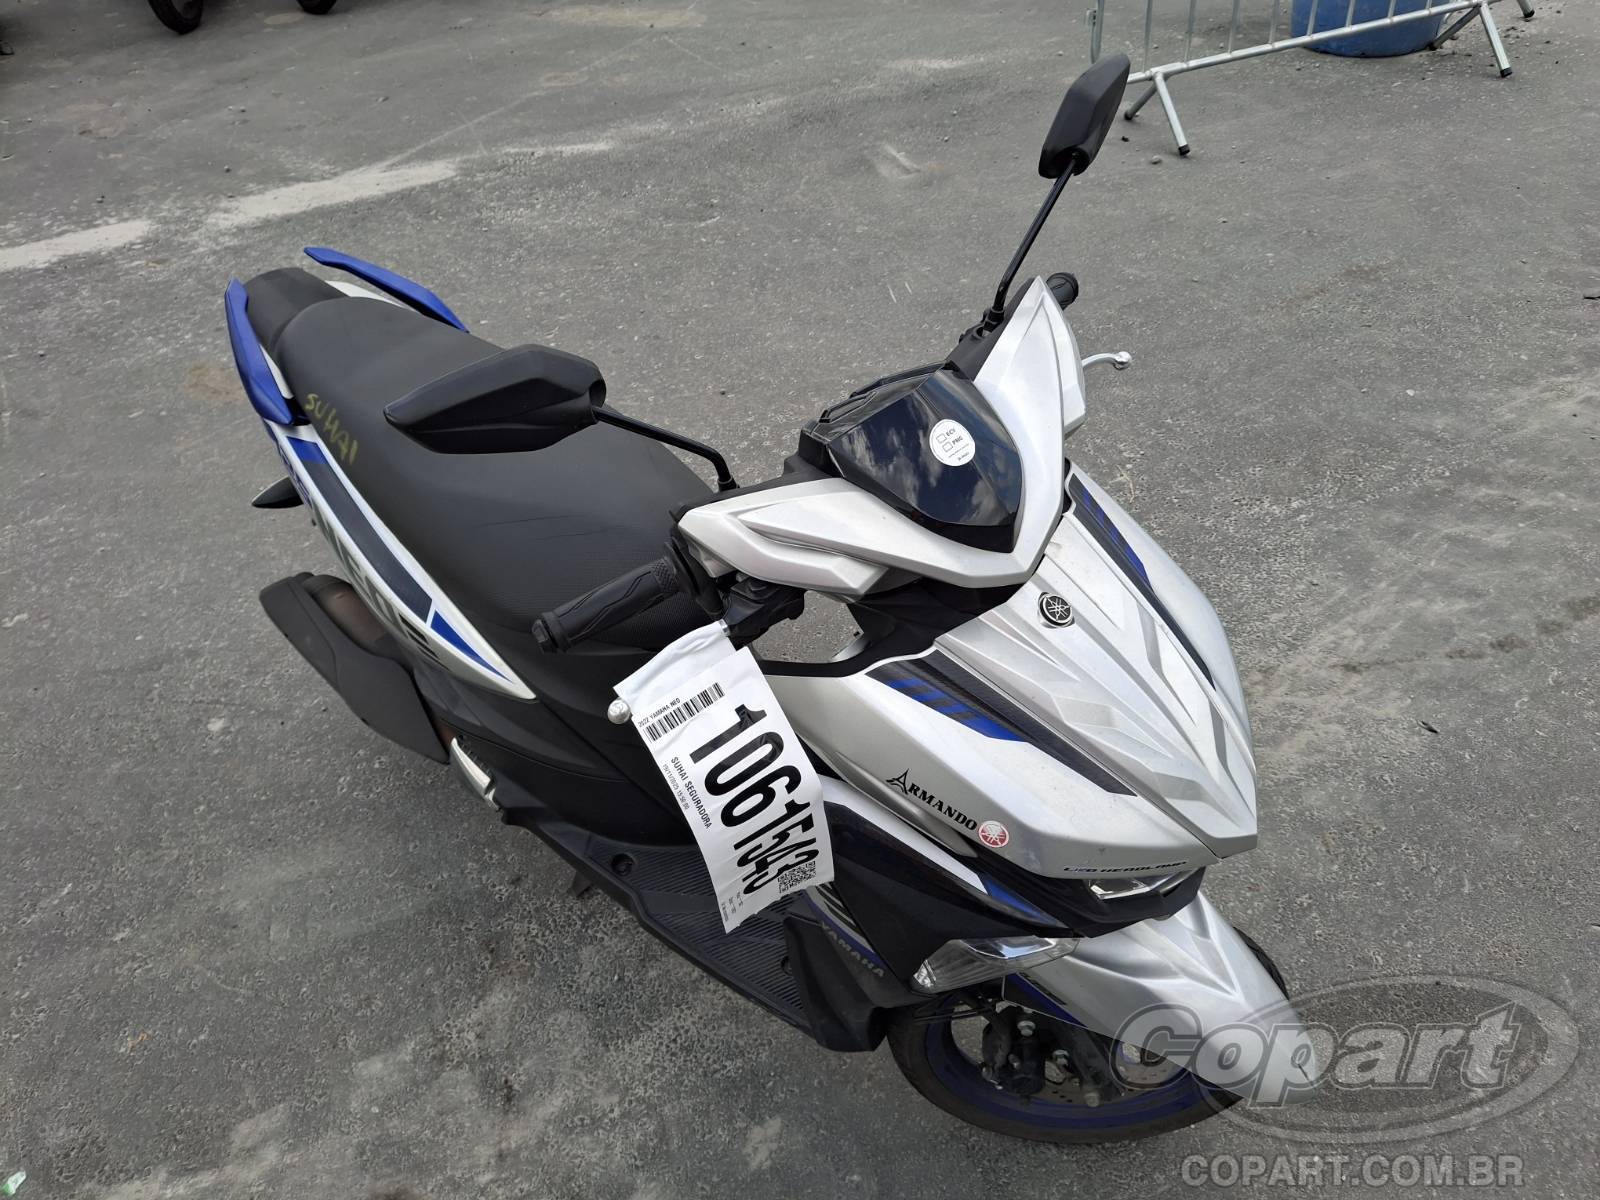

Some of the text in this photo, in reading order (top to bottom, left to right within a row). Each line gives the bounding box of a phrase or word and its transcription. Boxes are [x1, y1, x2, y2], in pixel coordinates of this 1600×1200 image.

[649, 704, 670, 719] YAMAHA
[669, 697, 681, 707] NEO
[671, 756, 712, 829] SUHAI SEGURADORA
[690, 704, 820, 894] 1061543
[886, 768, 979, 832] ARMANDO
[821, 920, 885, 978] YAMAHA
